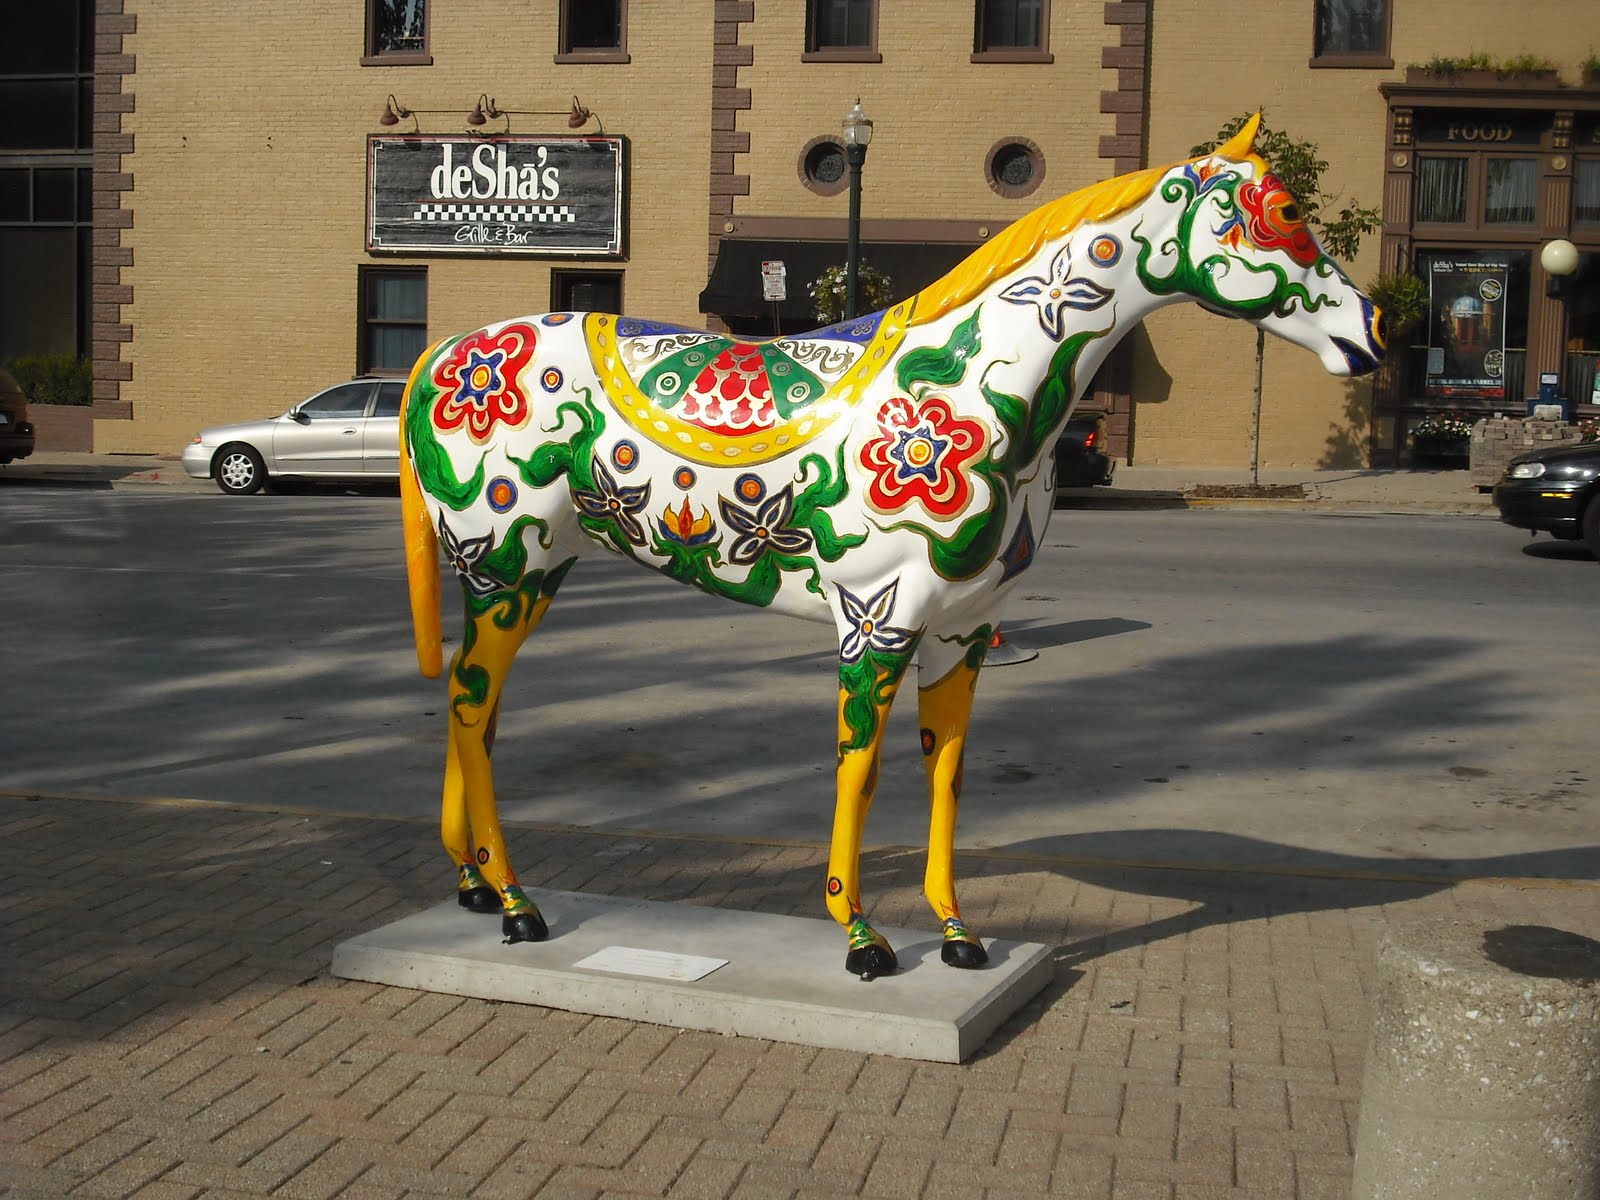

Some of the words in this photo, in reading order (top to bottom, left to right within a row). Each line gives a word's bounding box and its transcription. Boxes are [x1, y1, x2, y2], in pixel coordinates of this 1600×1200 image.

[1447, 122, 1513, 141] FOOD
[454, 223, 495, 243] Grille
[502, 221, 533, 246] Bar
